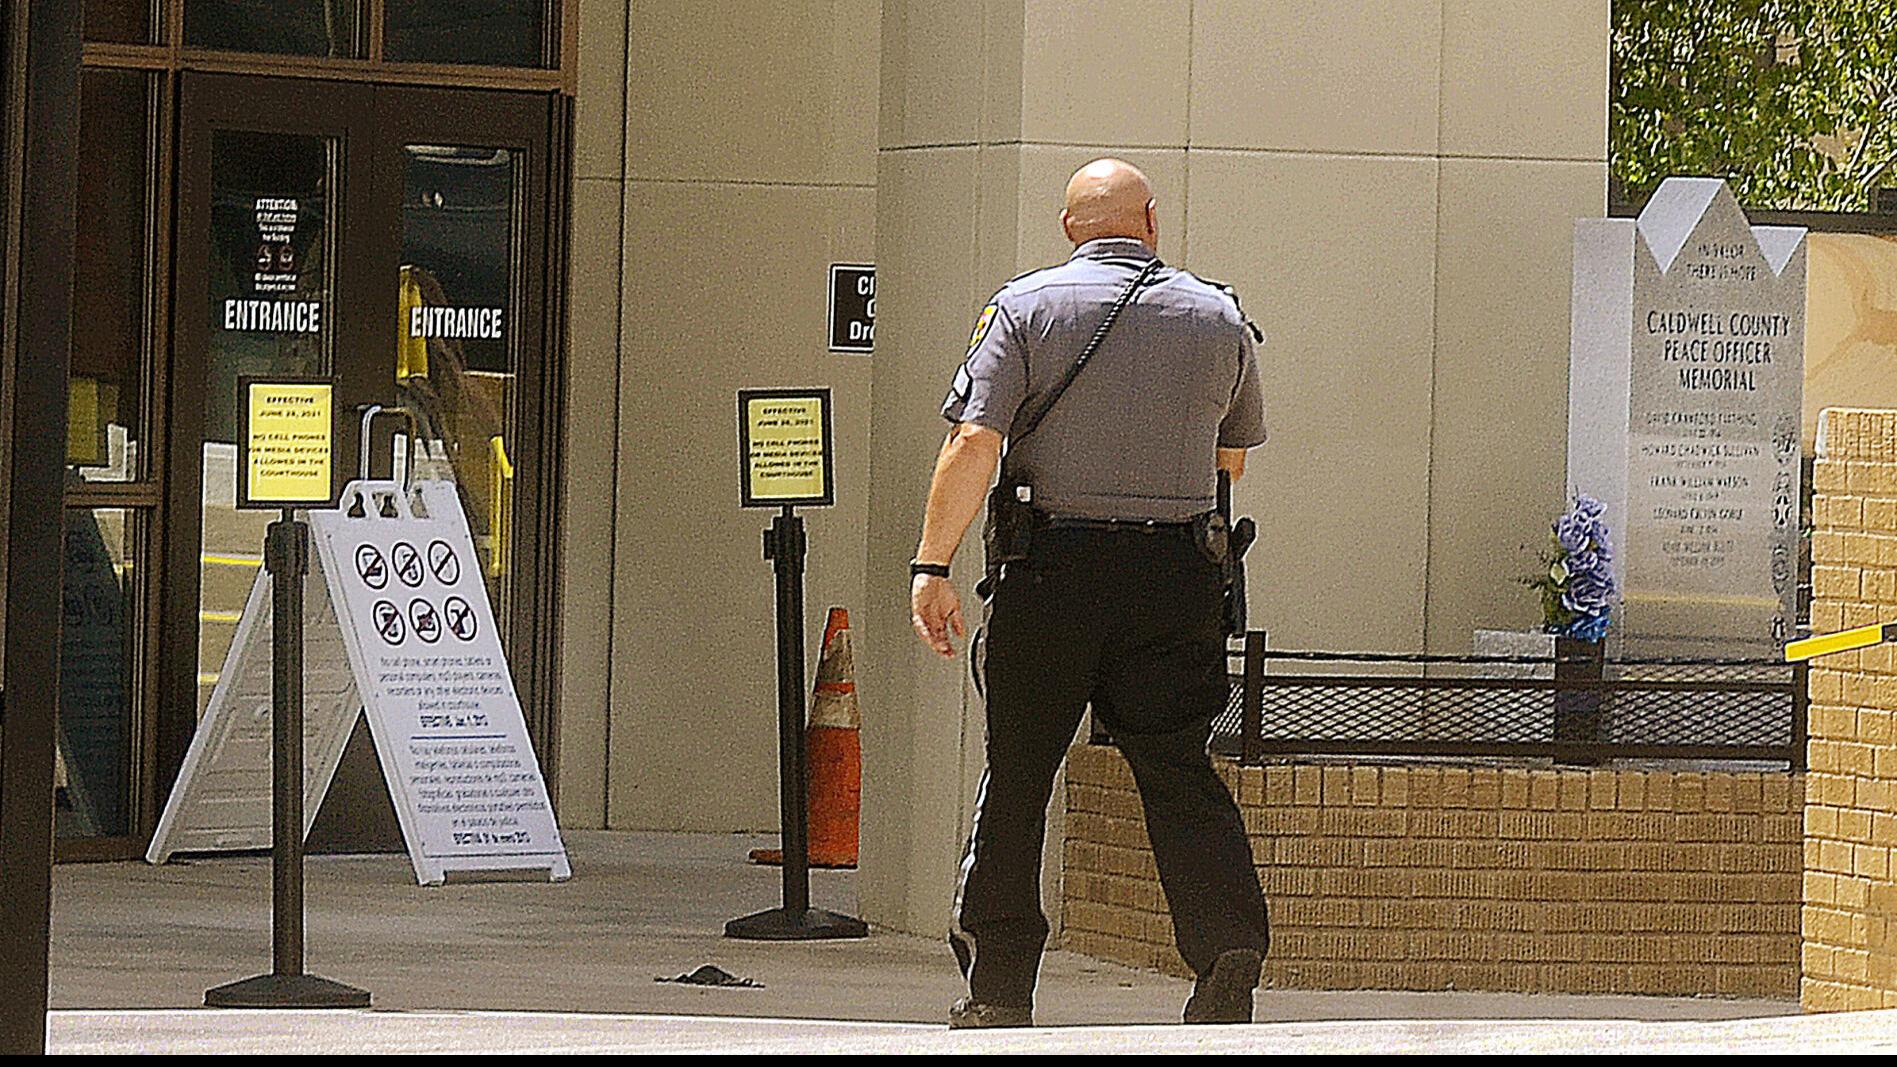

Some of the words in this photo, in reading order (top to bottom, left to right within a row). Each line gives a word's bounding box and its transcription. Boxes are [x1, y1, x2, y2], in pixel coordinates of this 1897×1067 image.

[224, 300, 320, 332] ENTRANCE
[411, 306, 502, 339] ENTRANCE
[1647, 311, 1724, 335] CALDWELL
[1730, 313, 1790, 336] COUNTY
[1664, 340, 1708, 362] PEACE
[1714, 341, 1771, 364] OFFICER
[1680, 368, 1756, 391] MEMORIAL
[266, 396, 314, 404] EFFECTIVE
[259, 410, 282, 418] JUNE
[763, 407, 806, 415] EFFECTIVE
[260, 470, 318, 478] COURTHOUSE
[760, 470, 813, 479] COURTHOUSE
